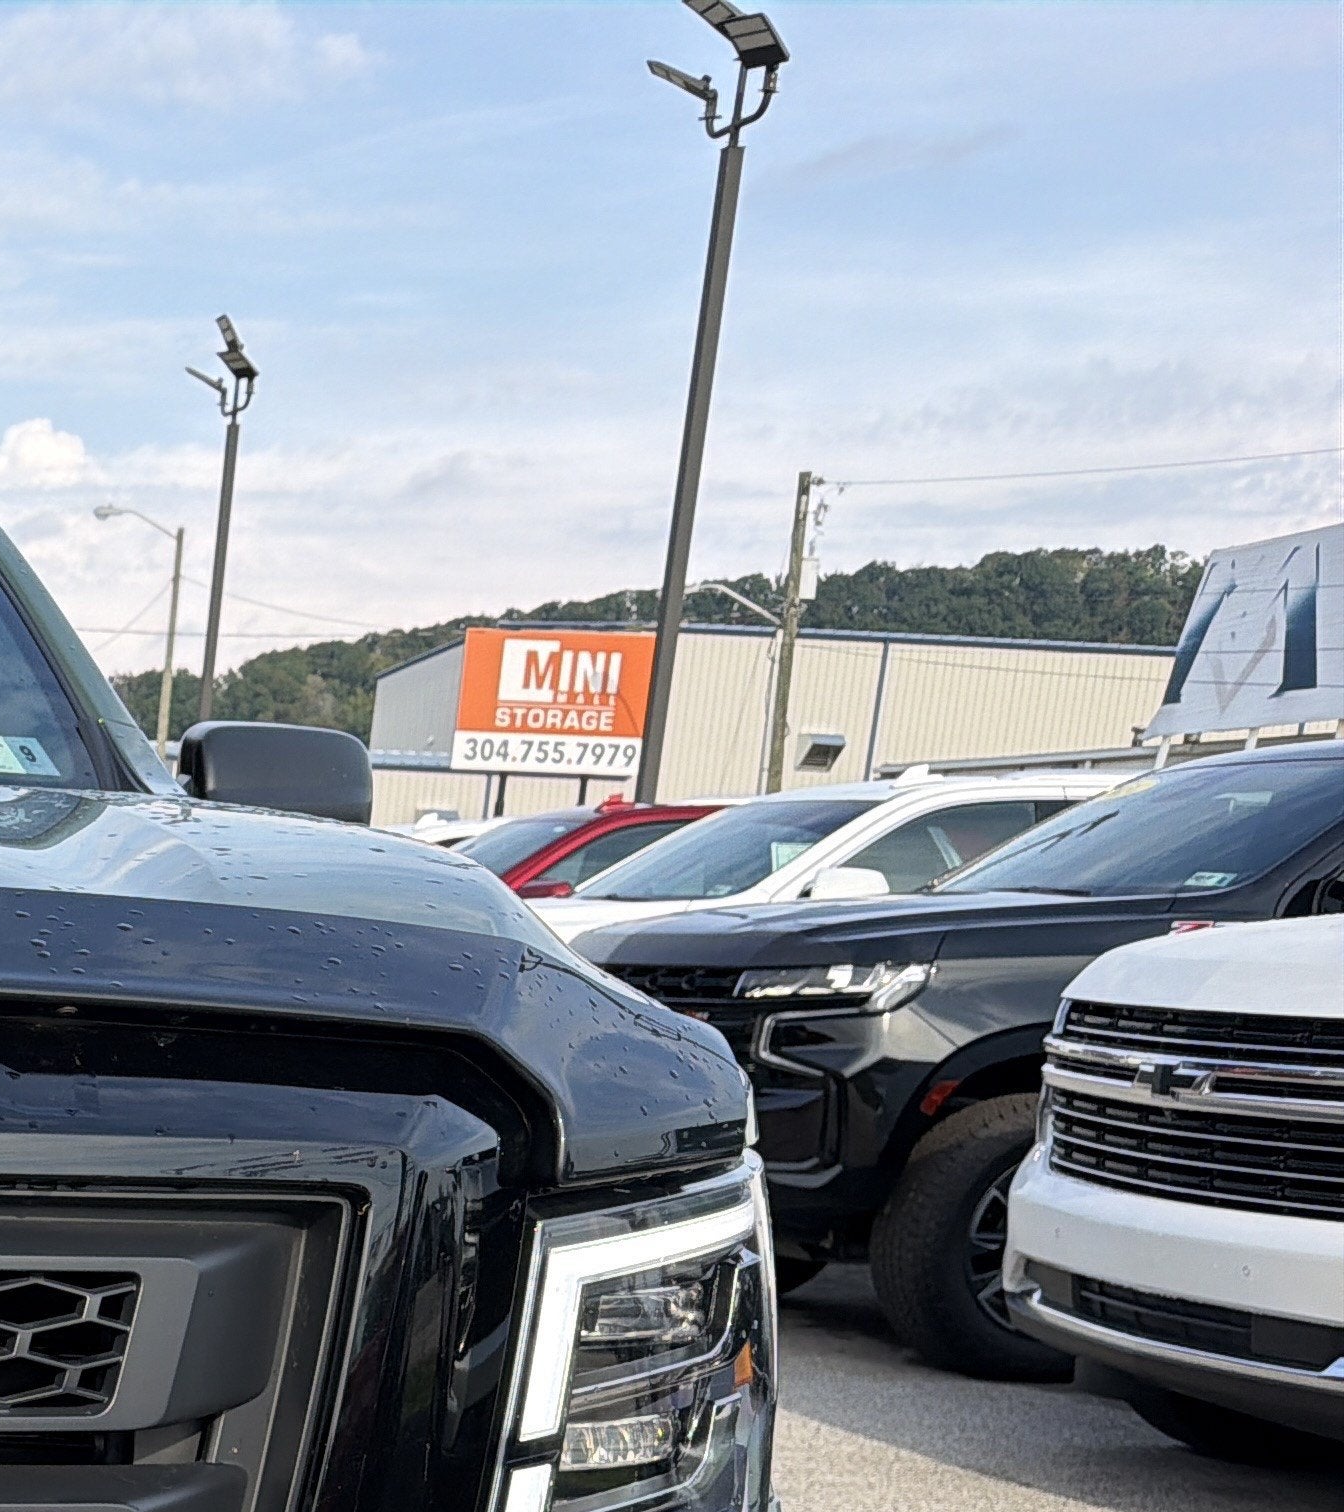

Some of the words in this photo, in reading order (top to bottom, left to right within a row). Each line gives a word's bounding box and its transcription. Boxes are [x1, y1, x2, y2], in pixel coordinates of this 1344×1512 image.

[520, 648, 624, 695] MINI
[494, 706, 616, 732] STORAGE
[464, 737, 638, 768] 304.755.7979
